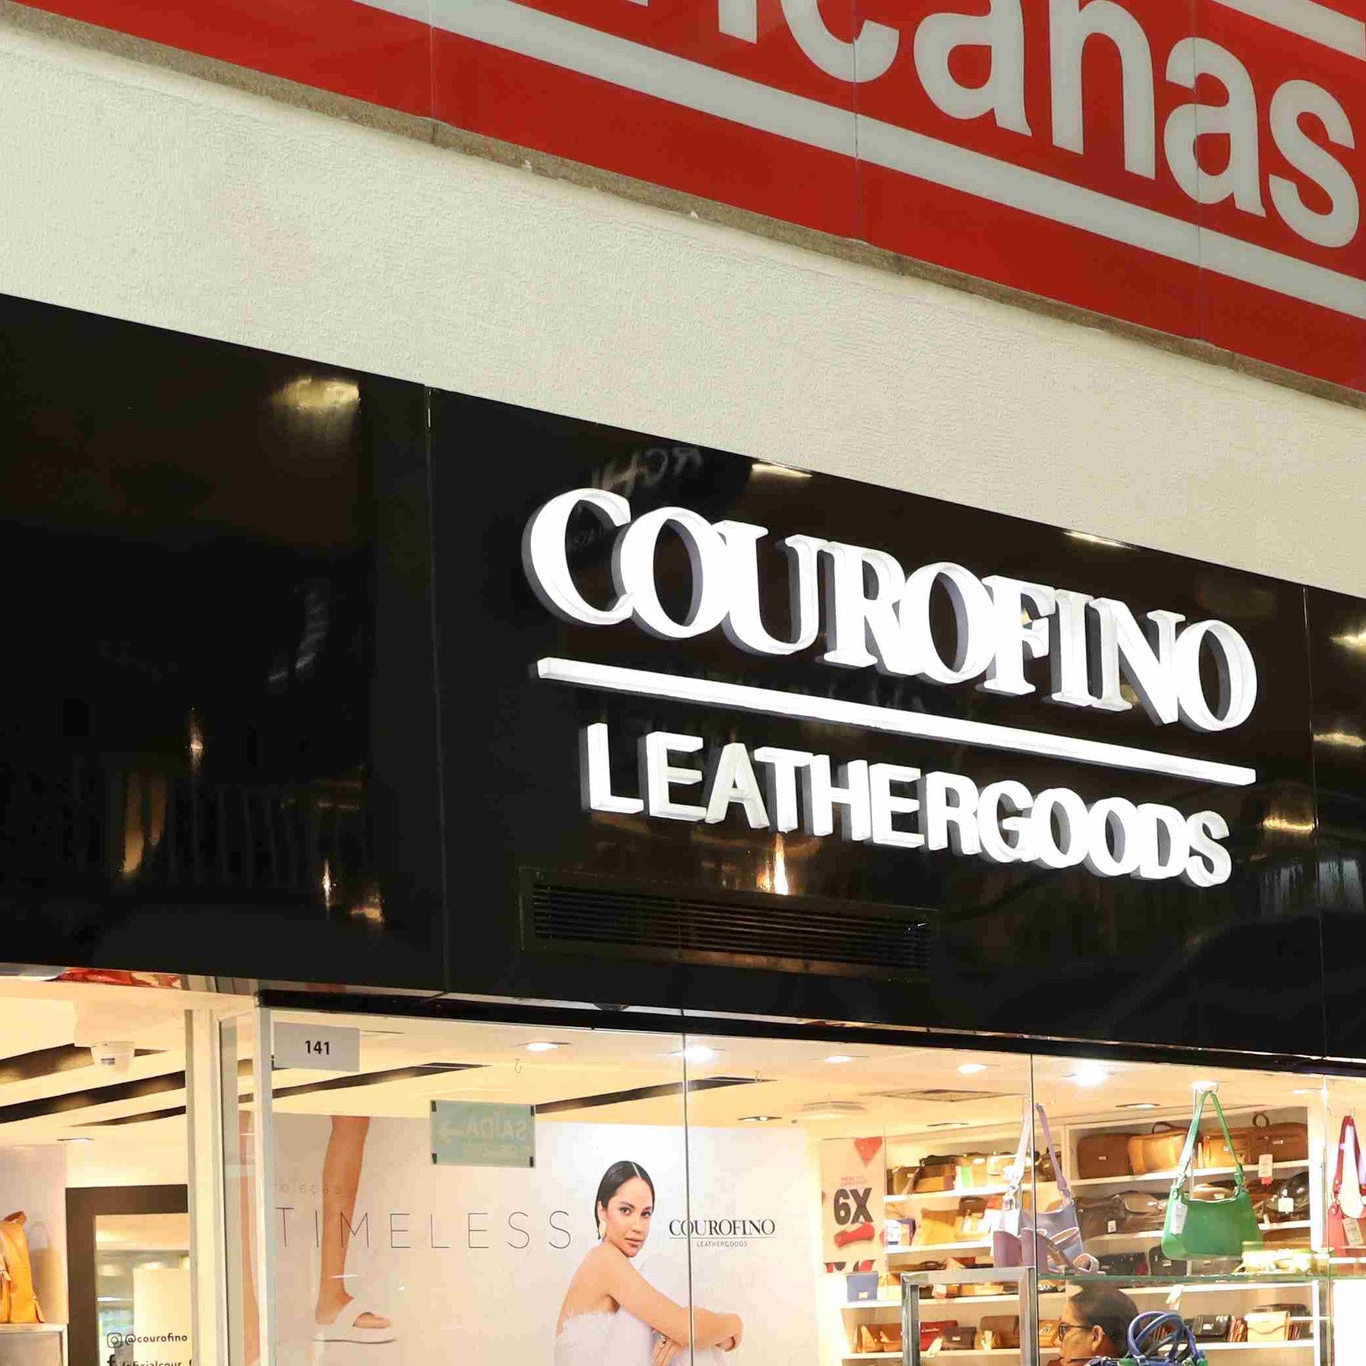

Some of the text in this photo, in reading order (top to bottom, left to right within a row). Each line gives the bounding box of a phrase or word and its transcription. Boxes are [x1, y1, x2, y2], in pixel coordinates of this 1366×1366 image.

[718, 0, 1360, 249] canas
[521, 487, 1259, 733] COUROFINO
[580, 721, 1233, 889] LEATHERGOODS
[304, 1040, 331, 1056] 141
[833, 1186, 874, 1226] 6X
[275, 1206, 573, 1250] TIMELESS
[668, 1218, 776, 1237] COUROFINO
[124, 1332, 188, 1346] @courofino
